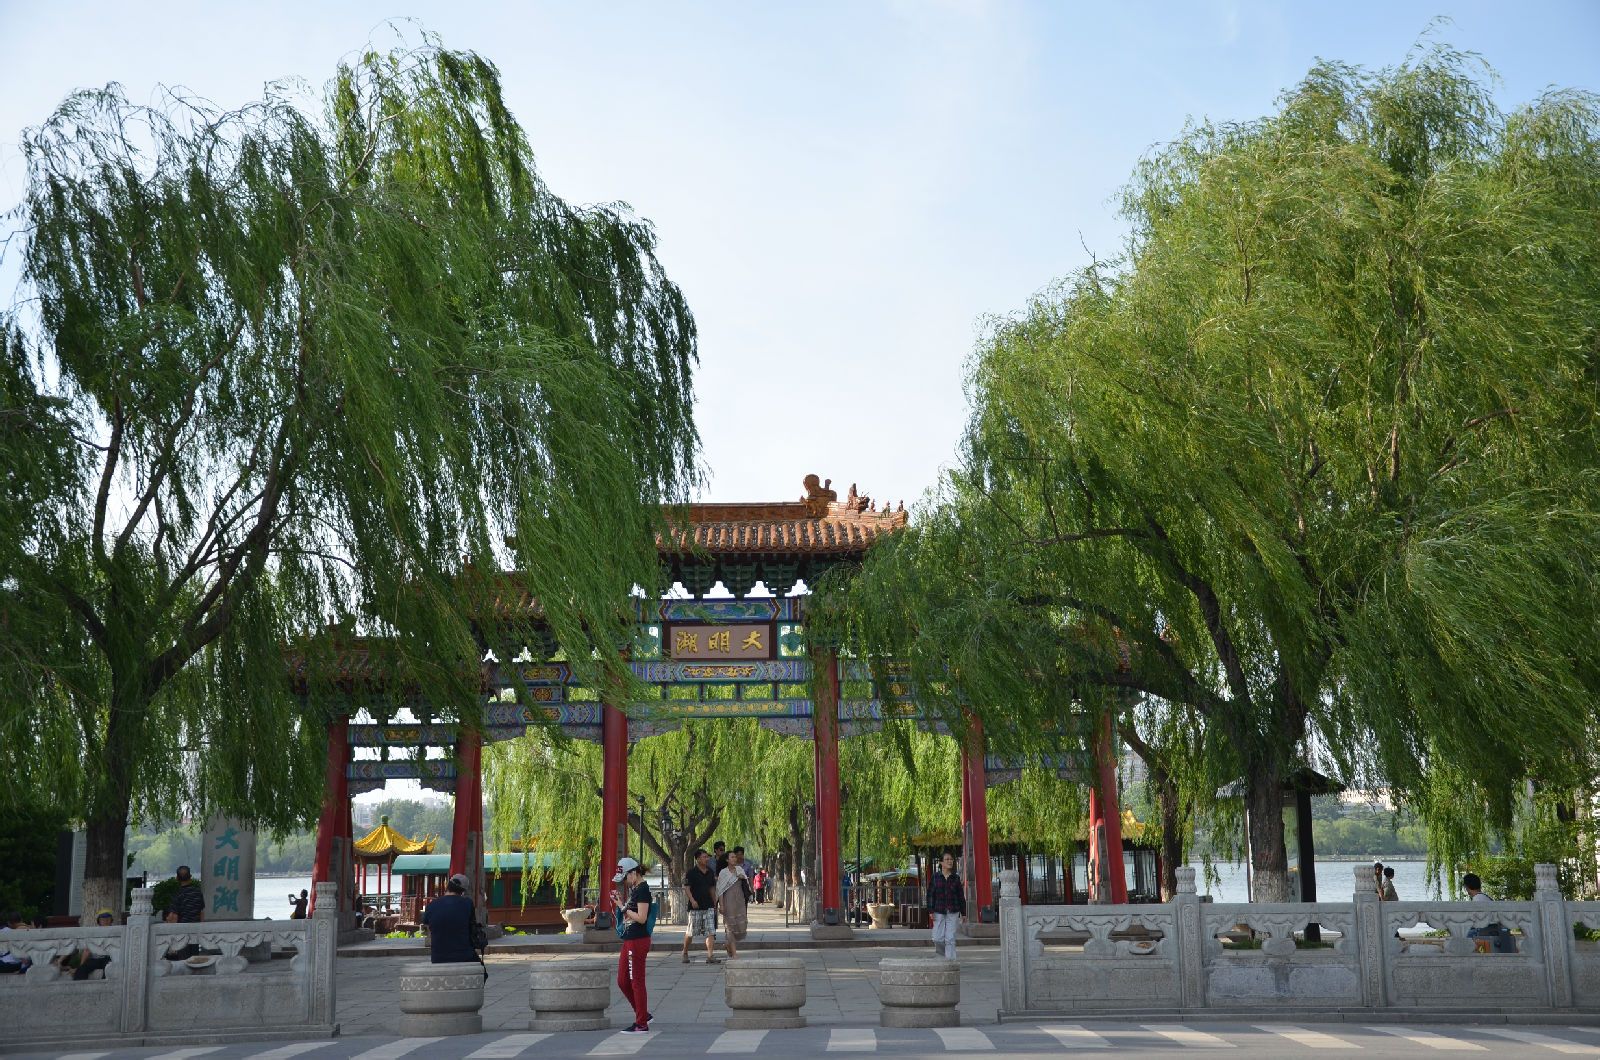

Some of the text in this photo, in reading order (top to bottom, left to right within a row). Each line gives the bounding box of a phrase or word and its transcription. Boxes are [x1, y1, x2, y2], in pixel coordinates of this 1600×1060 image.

[676, 630, 763, 654] 大明湖
[213, 827, 240, 914] 大明湖
